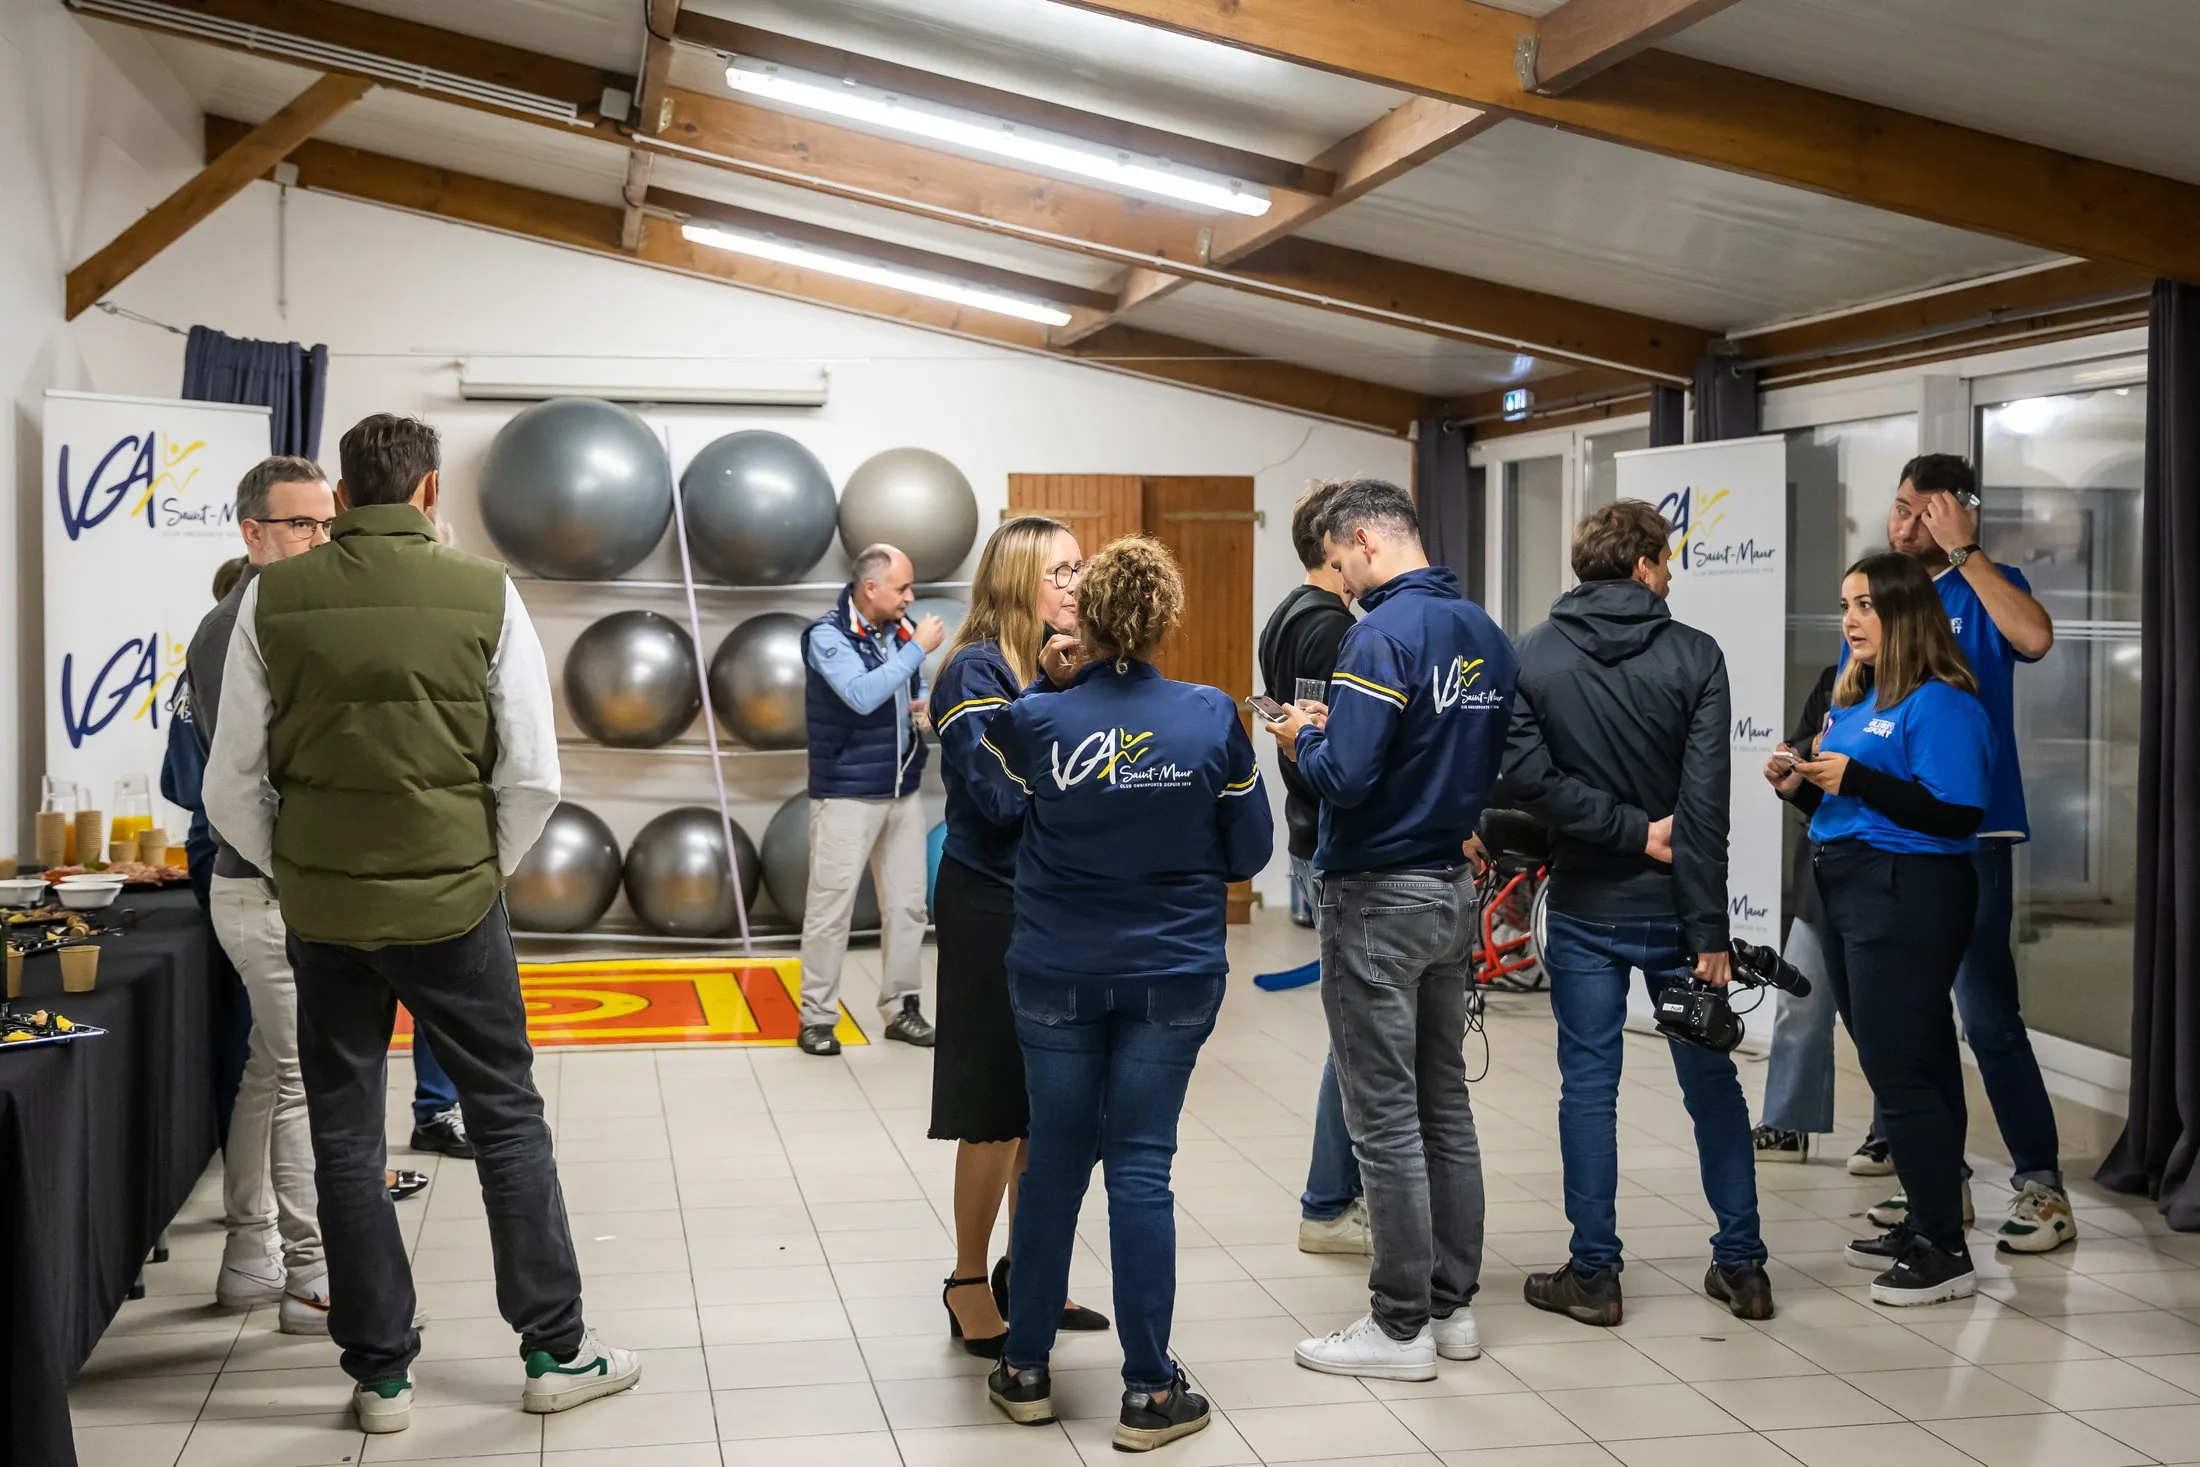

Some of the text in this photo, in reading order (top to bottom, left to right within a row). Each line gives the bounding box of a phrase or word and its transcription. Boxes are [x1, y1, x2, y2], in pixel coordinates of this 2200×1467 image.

[1693, 538, 1776, 568] Saint-Maur
[1051, 727, 1116, 791] VGA
[1119, 762, 1193, 783] Saint-Maur
